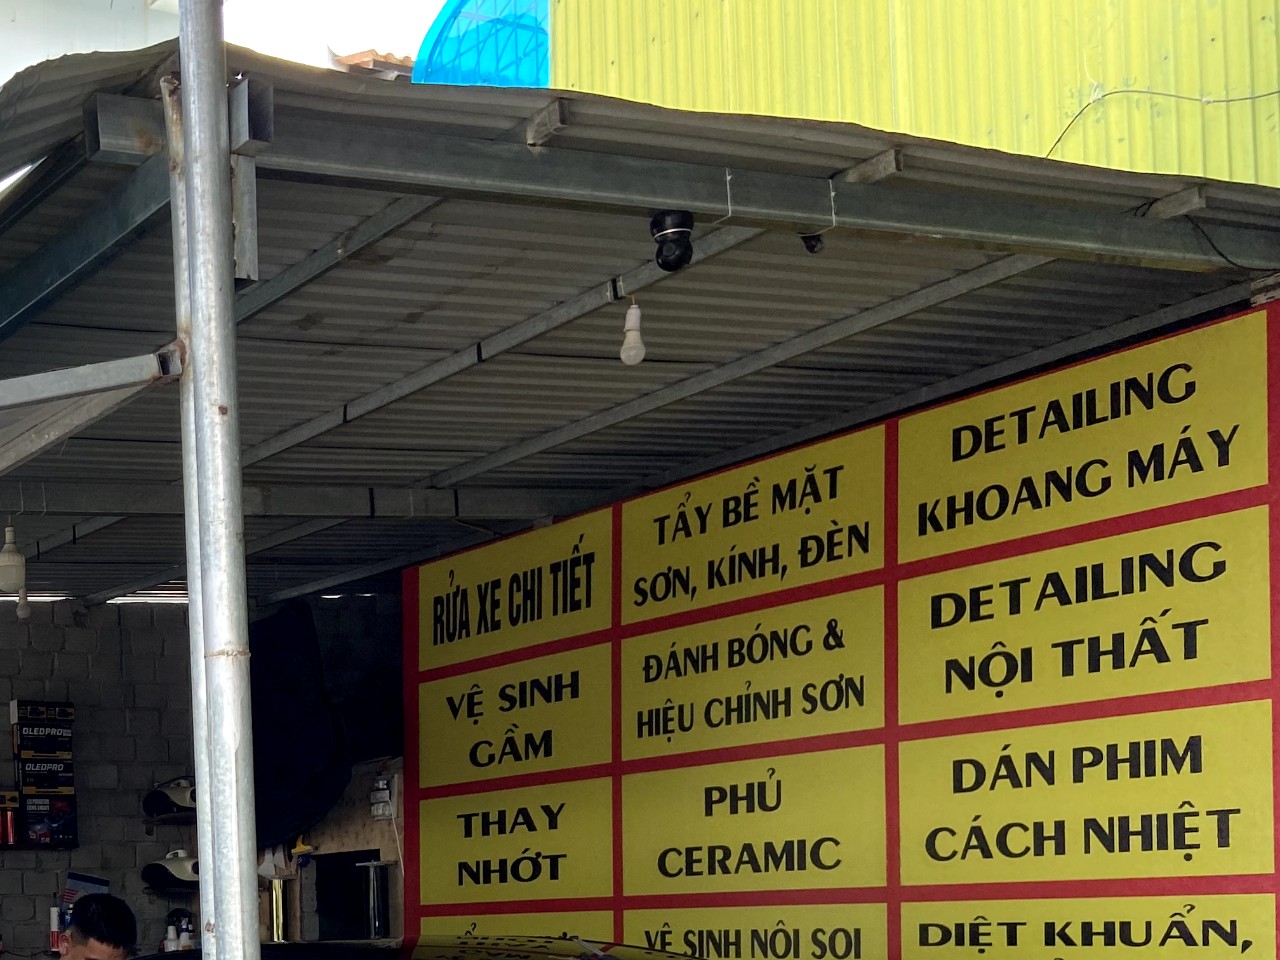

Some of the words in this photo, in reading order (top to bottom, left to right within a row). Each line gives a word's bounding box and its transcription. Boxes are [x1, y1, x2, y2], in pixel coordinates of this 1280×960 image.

[952, 363, 1196, 462] DETAILING
[653, 492, 712, 546] TẨY
[722, 476, 760, 529] BỀ
[771, 465, 844, 515] MẶT
[918, 459, 1112, 536] KHOANG
[1128, 424, 1240, 488] MÁY
[432, 569, 471, 646] RỬA
[476, 578, 501, 636] XE
[508, 565, 543, 627] CHI
[550, 533, 595, 617] TIẾT
[633, 565, 697, 606] SƠN,
[707, 544, 788, 590] KÍNH,
[797, 521, 870, 569] ĐÈN
[930, 541, 1227, 629] DETAILING
[643, 642, 719, 684] ĐÁNH
[728, 623, 813, 668] BÓNG
[823, 618, 846, 650] &
[945, 641, 1033, 698] NỘI
[1051, 608, 1209, 677] THẤT
[446, 684, 484, 725] VỆ
[498, 670, 579, 712] SINH
[637, 698, 694, 743] HIỆU
[704, 681, 791, 728] CHỈNH
[802, 673, 865, 715] SƠN
[469, 723, 553, 768] GẦM
[952, 744, 1055, 794] DÁN
[1072, 735, 1202, 784] PHIM
[457, 803, 566, 838] THAY
[704, 768, 782, 817] PHỦ
[657, 837, 842, 878] CERAMIC
[925, 815, 1066, 861] CÁCH
[1084, 801, 1241, 861] NHIỆT
[457, 851, 567, 886] NHỚT
[683, 929, 741, 959] SINH
[811, 928, 861, 960] SOI
[920, 916, 1026, 954] DIỆT
[1044, 904, 1252, 954] KHUẨN,
